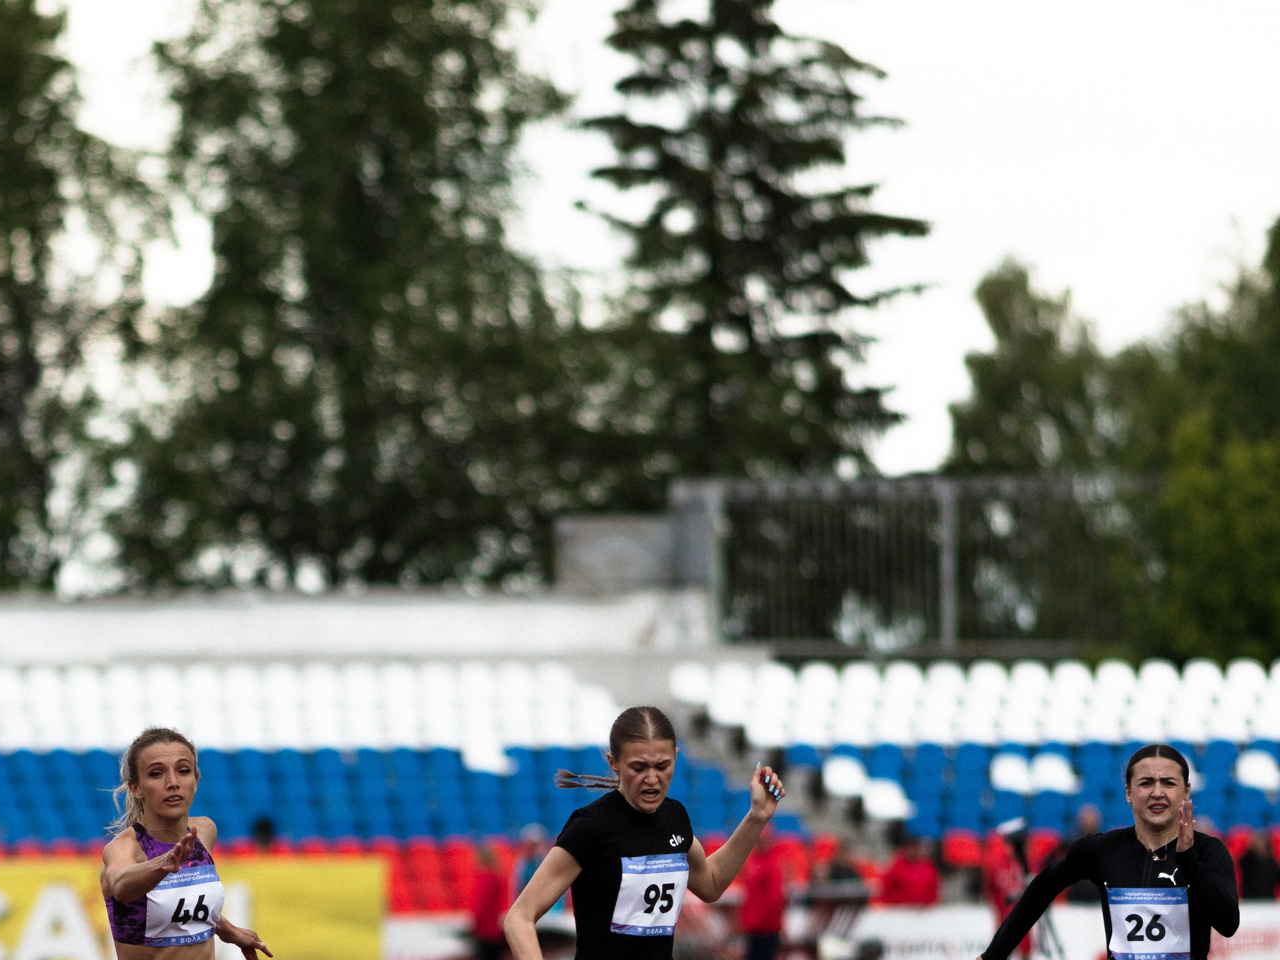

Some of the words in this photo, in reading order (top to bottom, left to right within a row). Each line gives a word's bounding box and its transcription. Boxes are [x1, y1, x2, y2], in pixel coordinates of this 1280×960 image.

[171, 894, 210, 925] 46
[643, 883, 675, 914] 95
[1124, 913, 1166, 942] 26
